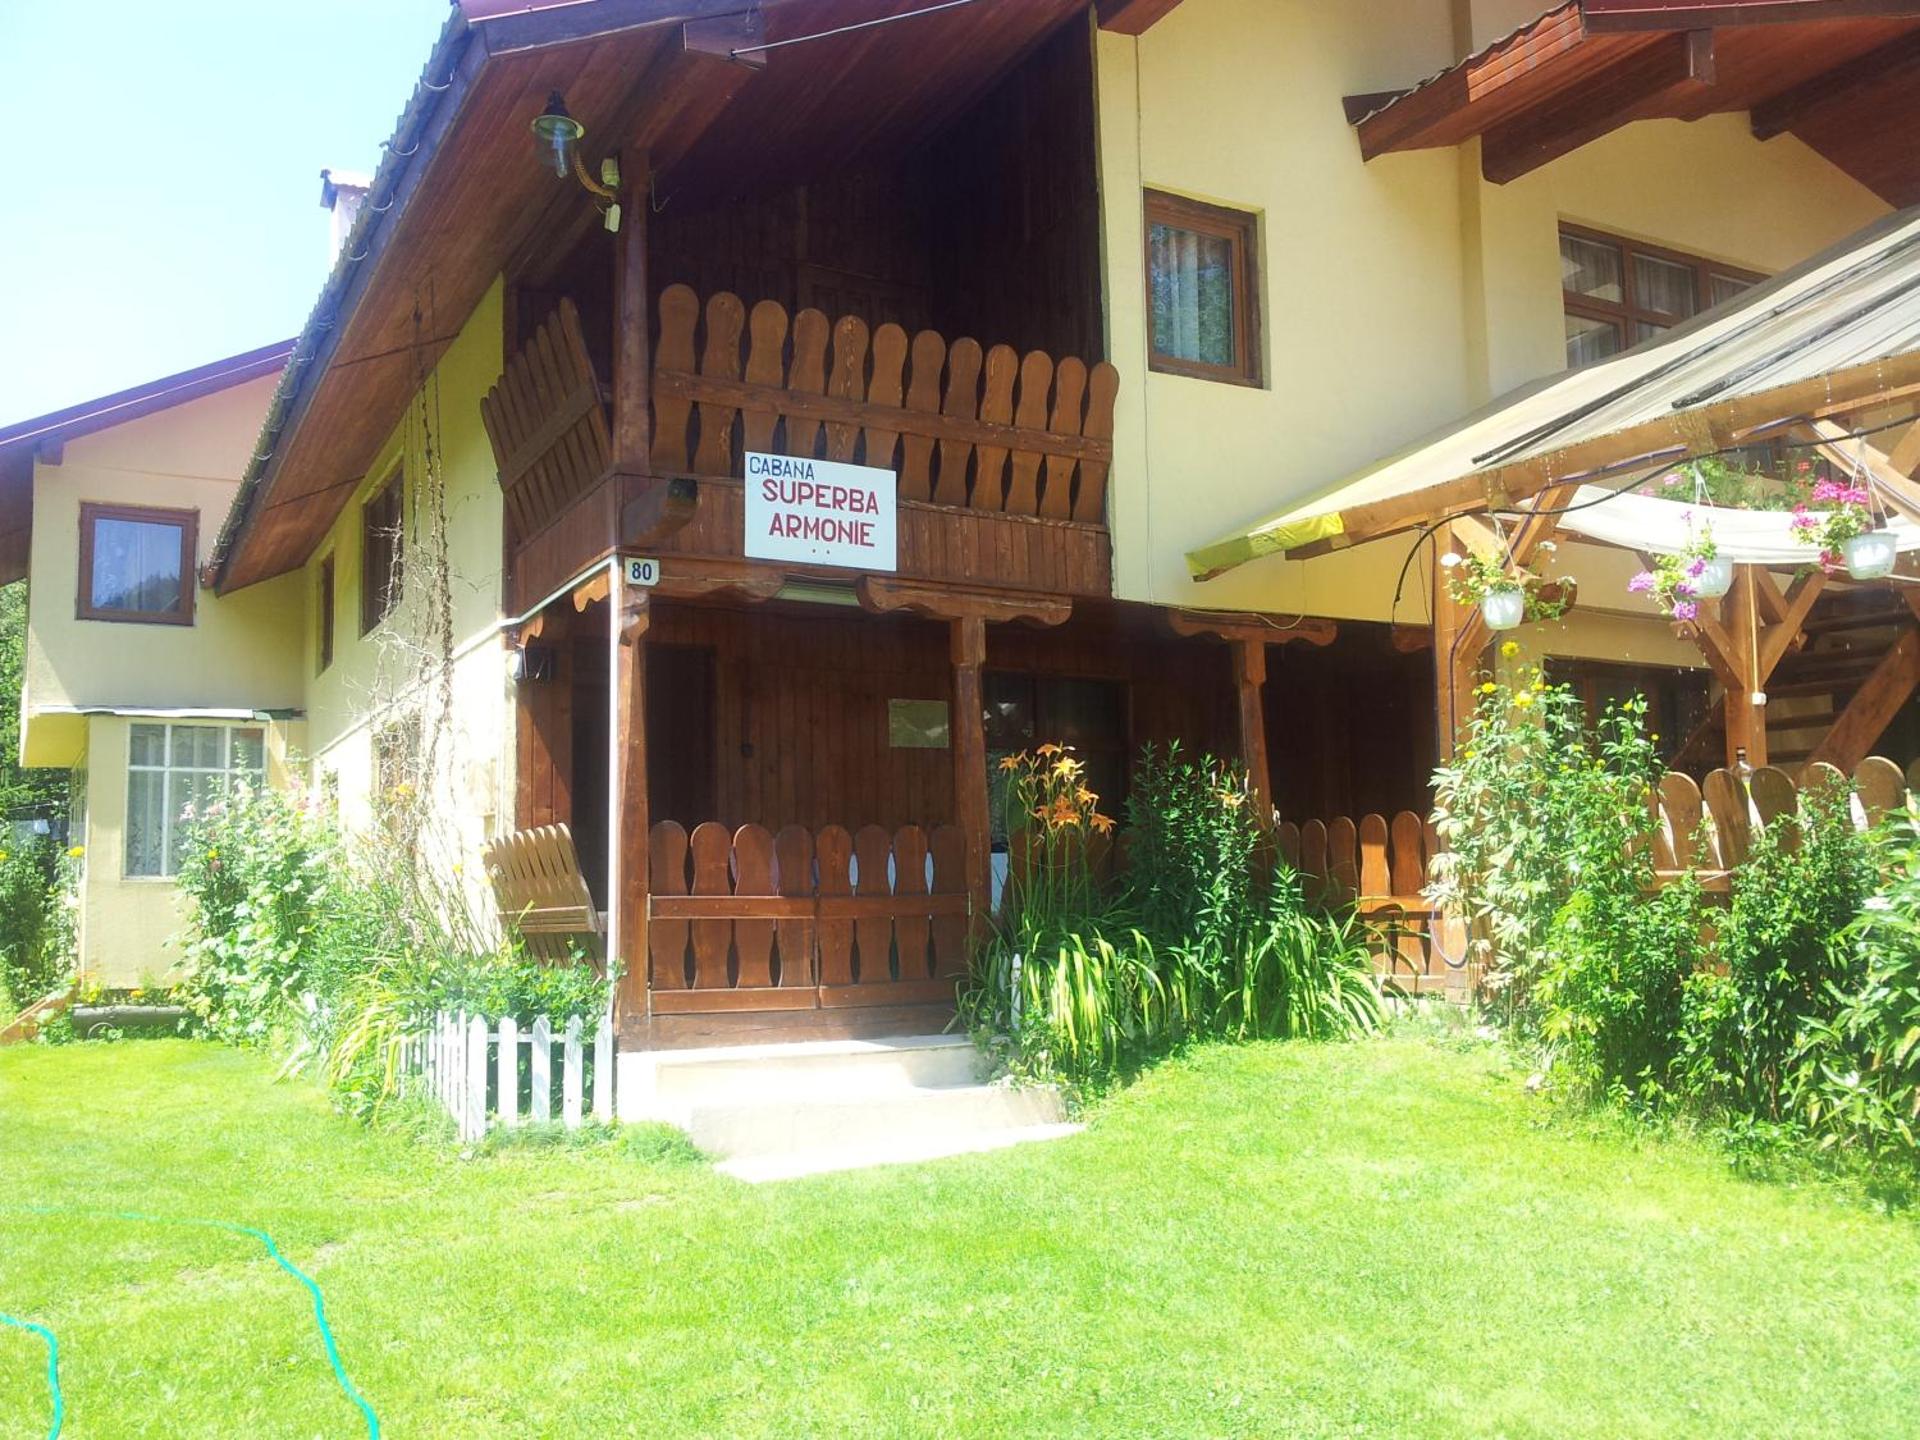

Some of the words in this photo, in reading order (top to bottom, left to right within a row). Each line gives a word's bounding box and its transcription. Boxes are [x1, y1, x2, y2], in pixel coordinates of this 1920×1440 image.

[750, 456, 815, 480] CABANA
[762, 478, 879, 515] SUPERBA
[768, 512, 875, 547] ARMONIE
[632, 562, 652, 580] 80
